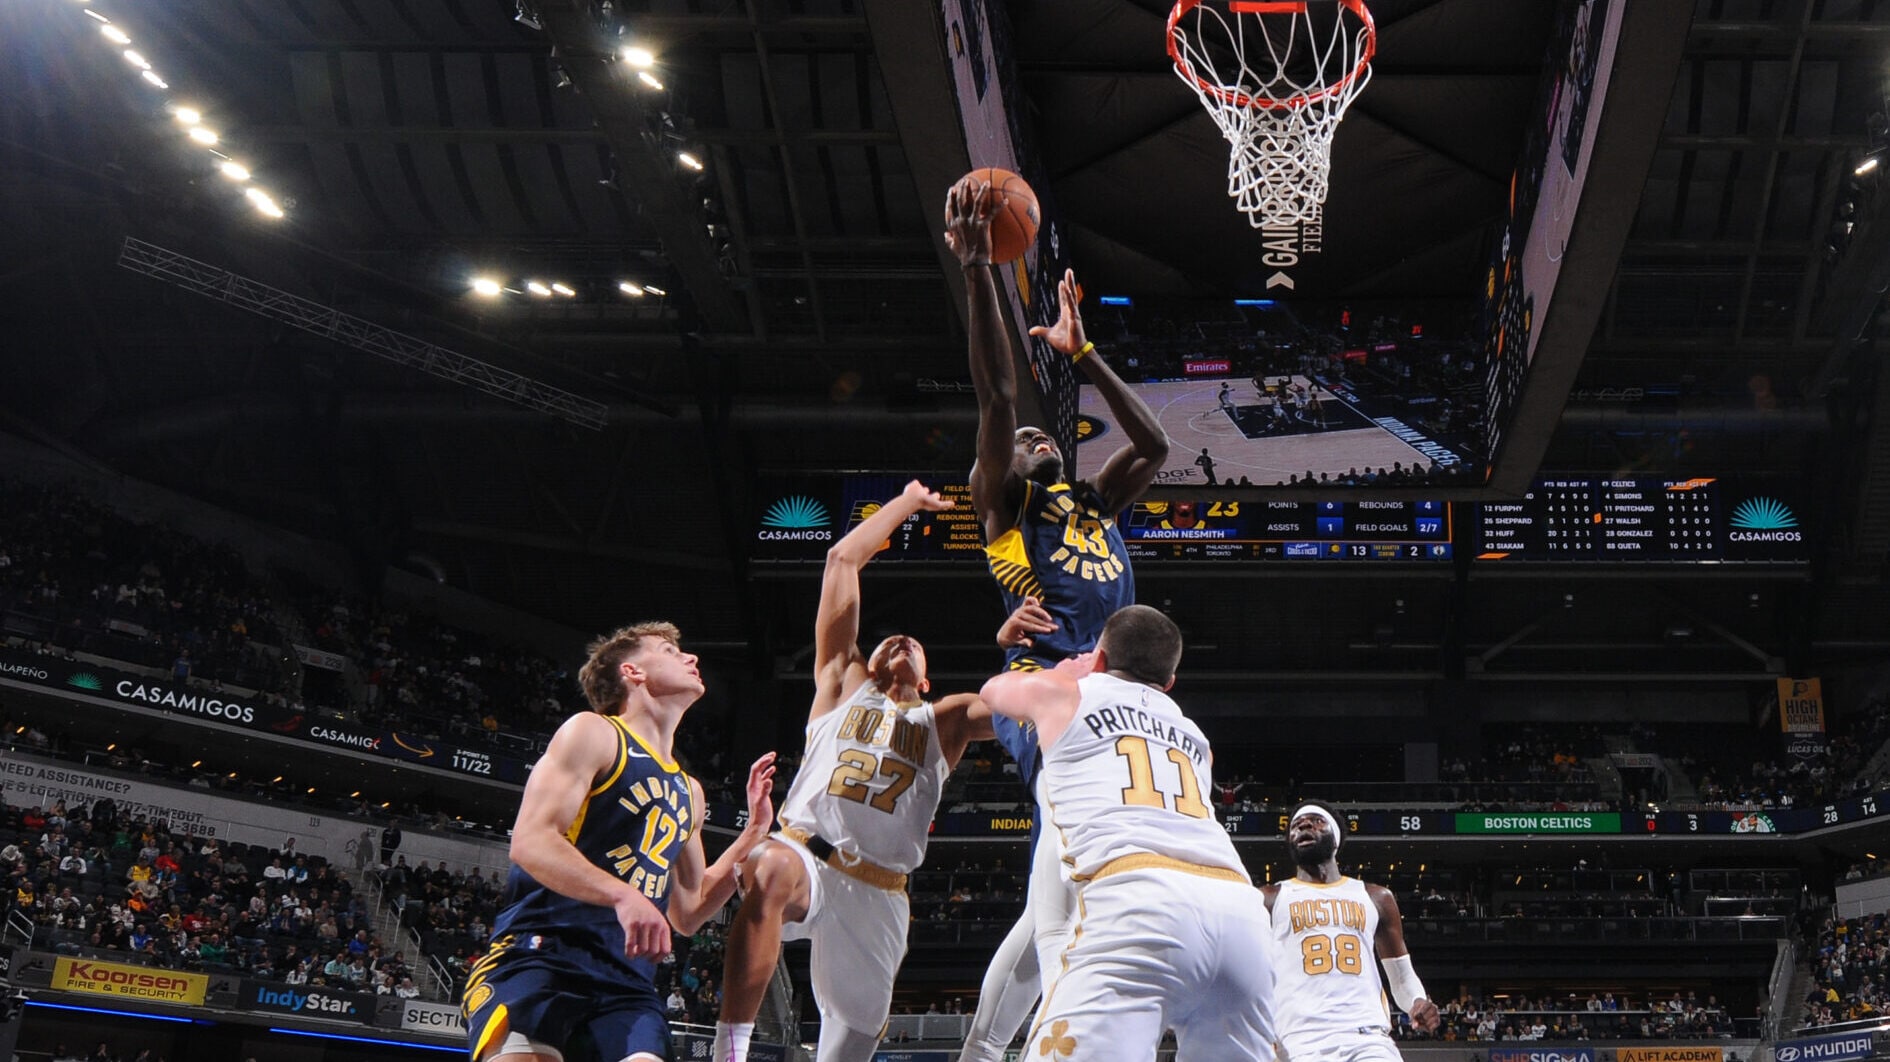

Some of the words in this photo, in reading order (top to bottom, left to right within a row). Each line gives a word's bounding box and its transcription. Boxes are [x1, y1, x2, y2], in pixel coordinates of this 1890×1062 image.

[1186, 362, 1229, 373] Emirates
[1373, 416, 1427, 442] INDIANA
[1207, 500, 1240, 517] 23
[1359, 501, 1404, 509] REBOUNDS
[758, 531, 832, 540] CASAMIGOS
[1143, 531, 1179, 539] AARON
[1182, 531, 1225, 539] NESMITH
[1420, 524, 1437, 532] 2/7
[1063, 513, 1110, 559] 43
[1729, 531, 1801, 541] CASAMIGOS
[1352, 546, 1366, 556] 13
[1410, 547, 1418, 556] 2
[1050, 547, 1124, 582] PACERS
[116, 680, 254, 723] CASAMIGOS
[1786, 699, 1818, 714] HIGH
[1787, 714, 1820, 725] OCTANE
[1084, 705, 1202, 766] PRITCHARD
[1787, 745, 1812, 753] LUCAS
[1813, 745, 1825, 753] OIL
[453, 756, 492, 774] 11/22
[36, 769, 131, 795] ASSISTANCE?
[827, 748, 917, 815] 27
[1115, 735, 1210, 819] 11
[29, 783, 96, 805] LOCATION
[618, 777, 689, 842] INDIANA
[1862, 803, 1876, 815] 14
[1400, 816, 1421, 831] 58
[1484, 817, 1537, 829] BOSTON
[1540, 817, 1592, 829] CELTICS
[1823, 811, 1838, 823] 28
[1225, 822, 1238, 832] 21
[1350, 820, 1358, 831] 3
[1647, 820, 1656, 831] 0
[1689, 820, 1698, 831] 3
[639, 804, 678, 869] 12
[1289, 899, 1367, 934] BOSTON
[1301, 934, 1362, 976] 88
[69, 962, 188, 992] Koorsen
[66, 979, 96, 990] FIRE
[103, 984, 113, 992] &
[119, 986, 186, 1000] SECURITY
[1638, 1051, 1661, 1061] LIFT
[1663, 1051, 1717, 1061] ACADEMY
[1804, 1038, 1872, 1059] HYUNDAI
